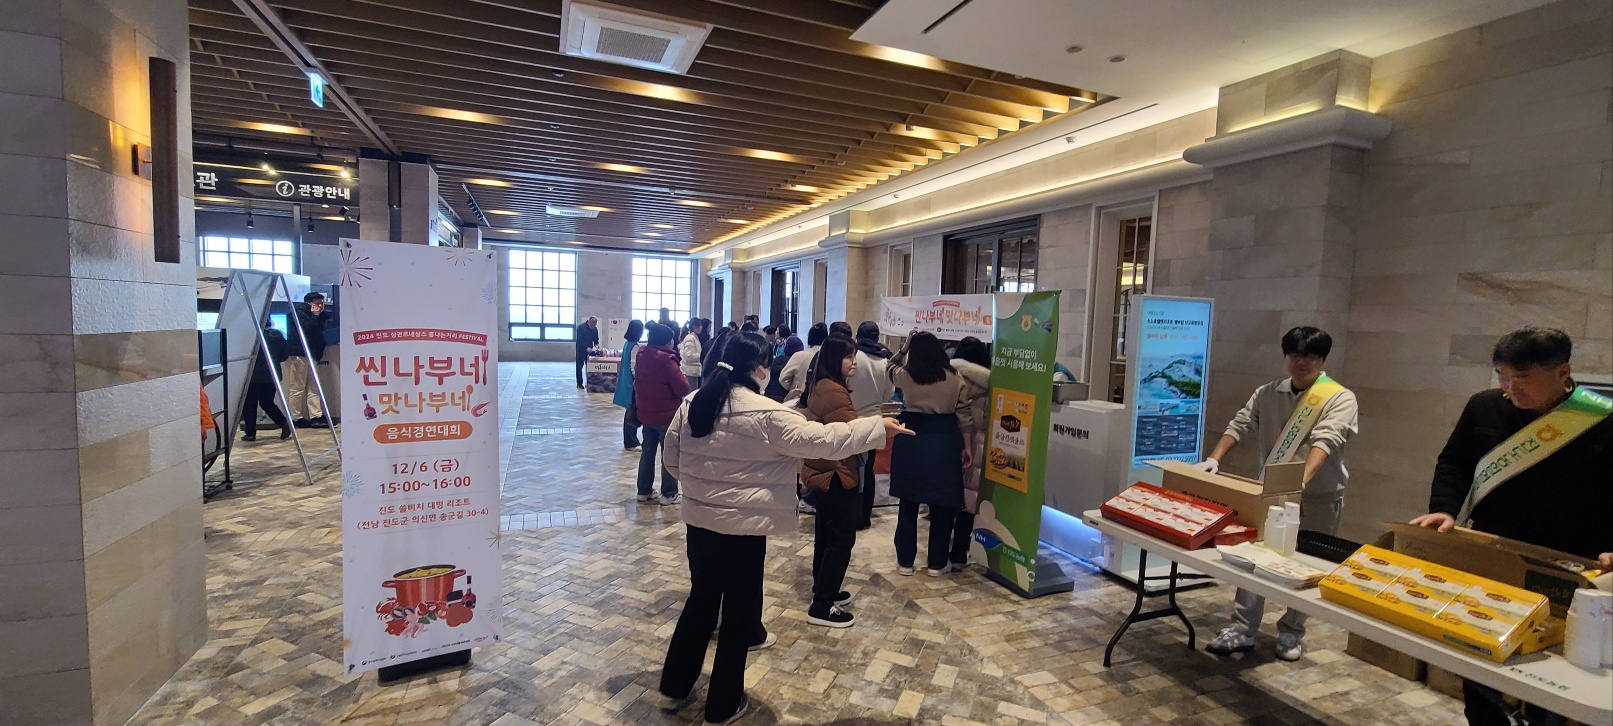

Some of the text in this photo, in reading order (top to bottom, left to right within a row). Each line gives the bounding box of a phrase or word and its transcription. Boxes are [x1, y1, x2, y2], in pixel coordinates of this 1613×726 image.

[298, 184, 350, 200] 관광안내
[459, 334, 484, 342] FESTIVAL
[1001, 346, 1037, 360] 지금 부담없이
[355, 349, 489, 386] 씬나부네
[1025, 361, 1047, 373] 보세요!
[378, 385, 474, 415] 맛나부네
[386, 424, 461, 440] 음식경연대회
[1053, 423, 1089, 439] 회원가입문의
[392, 458, 460, 475] 12/6 (금)
[380, 476, 471, 494] 15:00~16:00
[378, 498, 471, 515] 진도 쏠비치 대명 리조트
[357, 520, 379, 530] (전남
[382, 516, 409, 528] 진도군
[411, 513, 436, 525] 의신면
[466, 508, 489, 518] 30-4)
